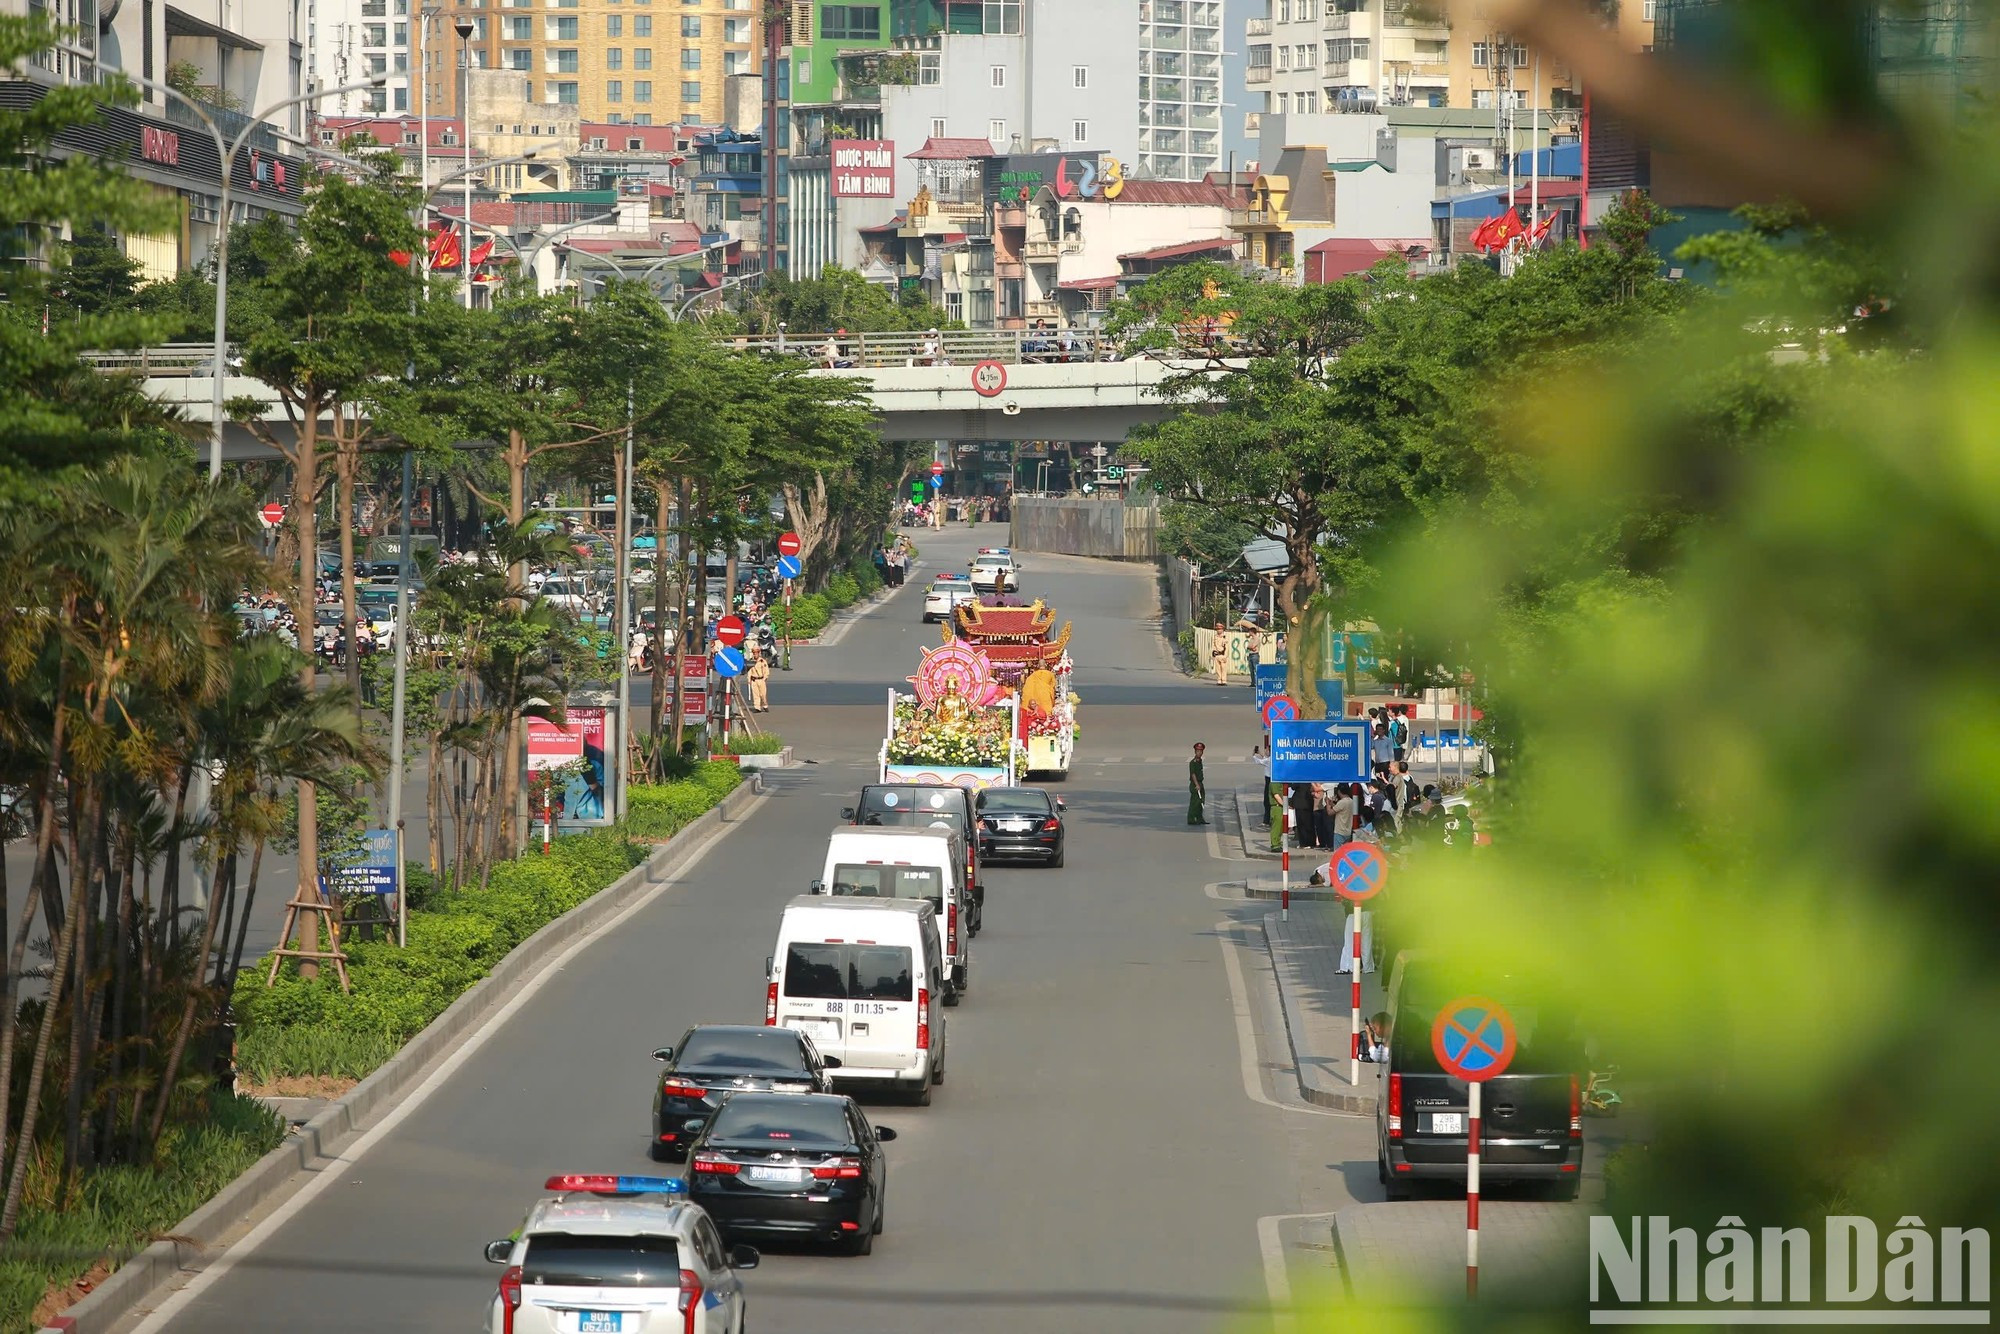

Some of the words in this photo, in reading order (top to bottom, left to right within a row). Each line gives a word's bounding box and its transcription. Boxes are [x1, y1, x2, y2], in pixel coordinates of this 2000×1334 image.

[835, 147, 862, 171] DƯỢC
[863, 143, 891, 168] PHẨM
[837, 172, 861, 193] TÂM
[863, 173, 890, 194] BÌNH
[980, 371, 999, 382] 4,75m
[1108, 466, 1124, 479] 54
[1277, 736, 1292, 748] NHÀ
[1293, 736, 1316, 748] KHÁCH
[1318, 739, 1327, 748] LA
[1329, 736, 1352, 748] THÀNH
[1275, 751, 1285, 760] La
[1285, 751, 1306, 760] Thanh
[1308, 751, 1327, 760] Guest
[1328, 751, 1349, 760] House
[369, 876, 391, 884] Palace
[826, 1001, 843, 1013] 88B
[854, 1003, 884, 1015] 011.35
[1439, 1114, 1454, 1123] 29B
